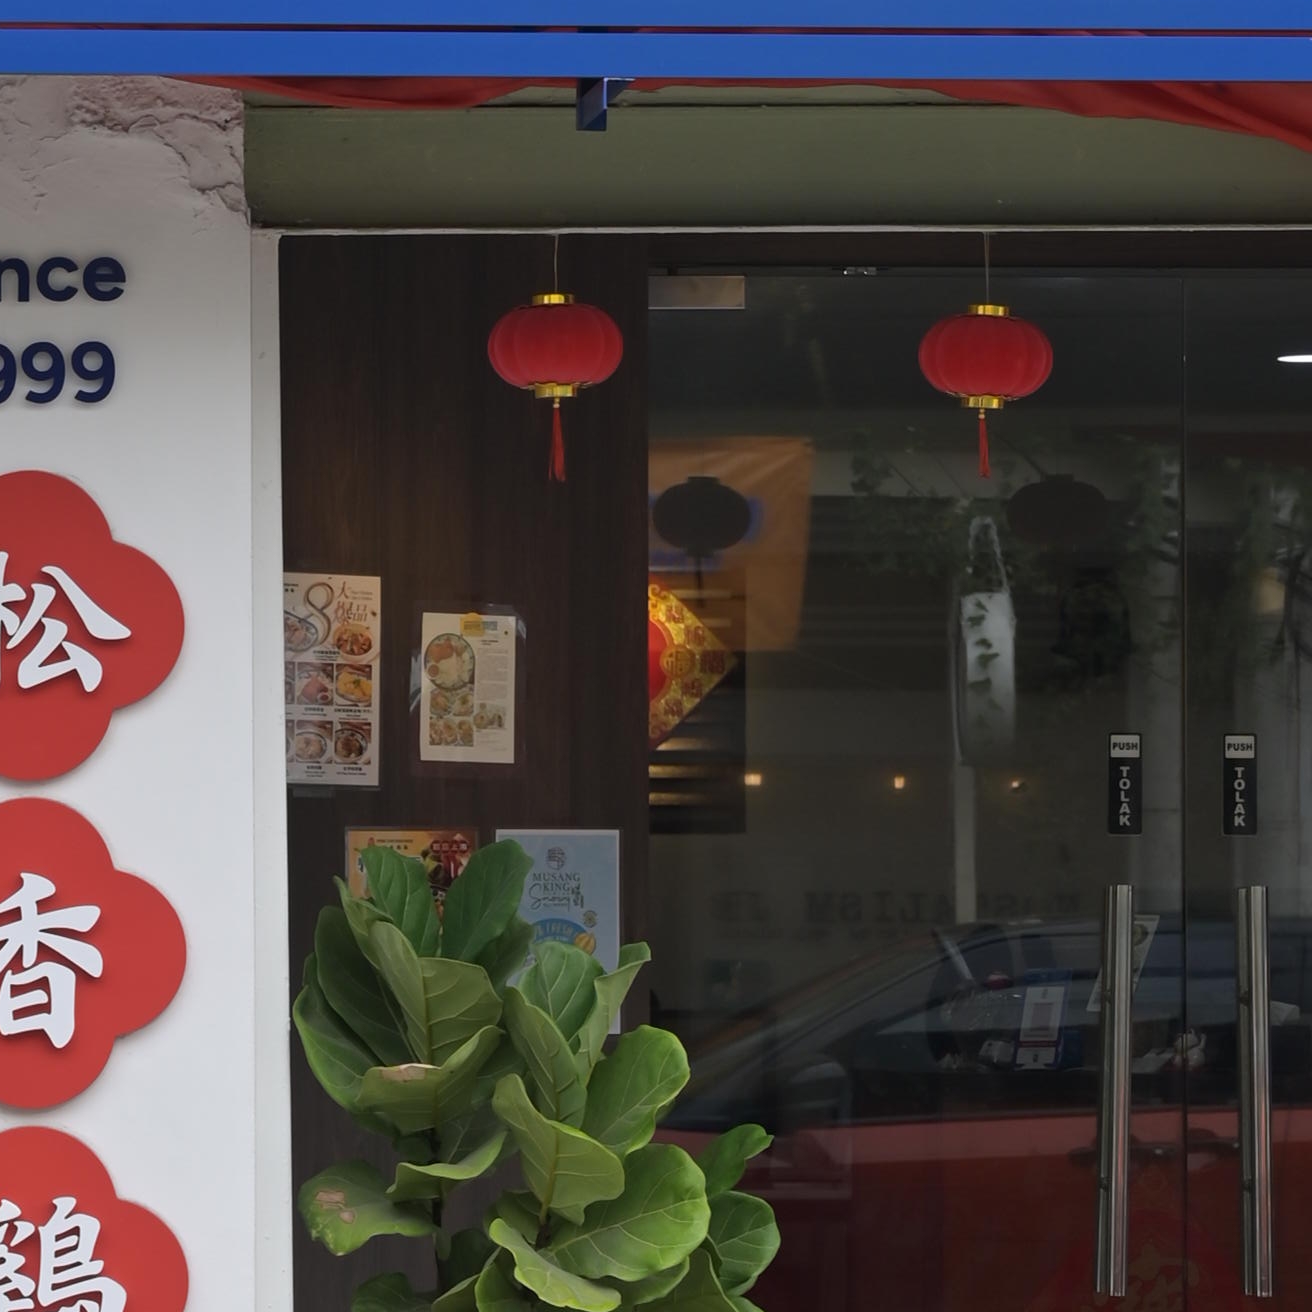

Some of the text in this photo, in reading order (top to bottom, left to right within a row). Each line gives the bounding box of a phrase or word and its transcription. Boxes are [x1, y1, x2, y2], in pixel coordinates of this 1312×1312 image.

[1112, 742, 1139, 751] PUSH
[1227, 743, 1253, 752] PUSH
[1118, 765, 1132, 827] TOLAK
[1233, 766, 1247, 828] TOLAK
[532, 872, 581, 882] MUSANG
[543, 882, 570, 892] KING
